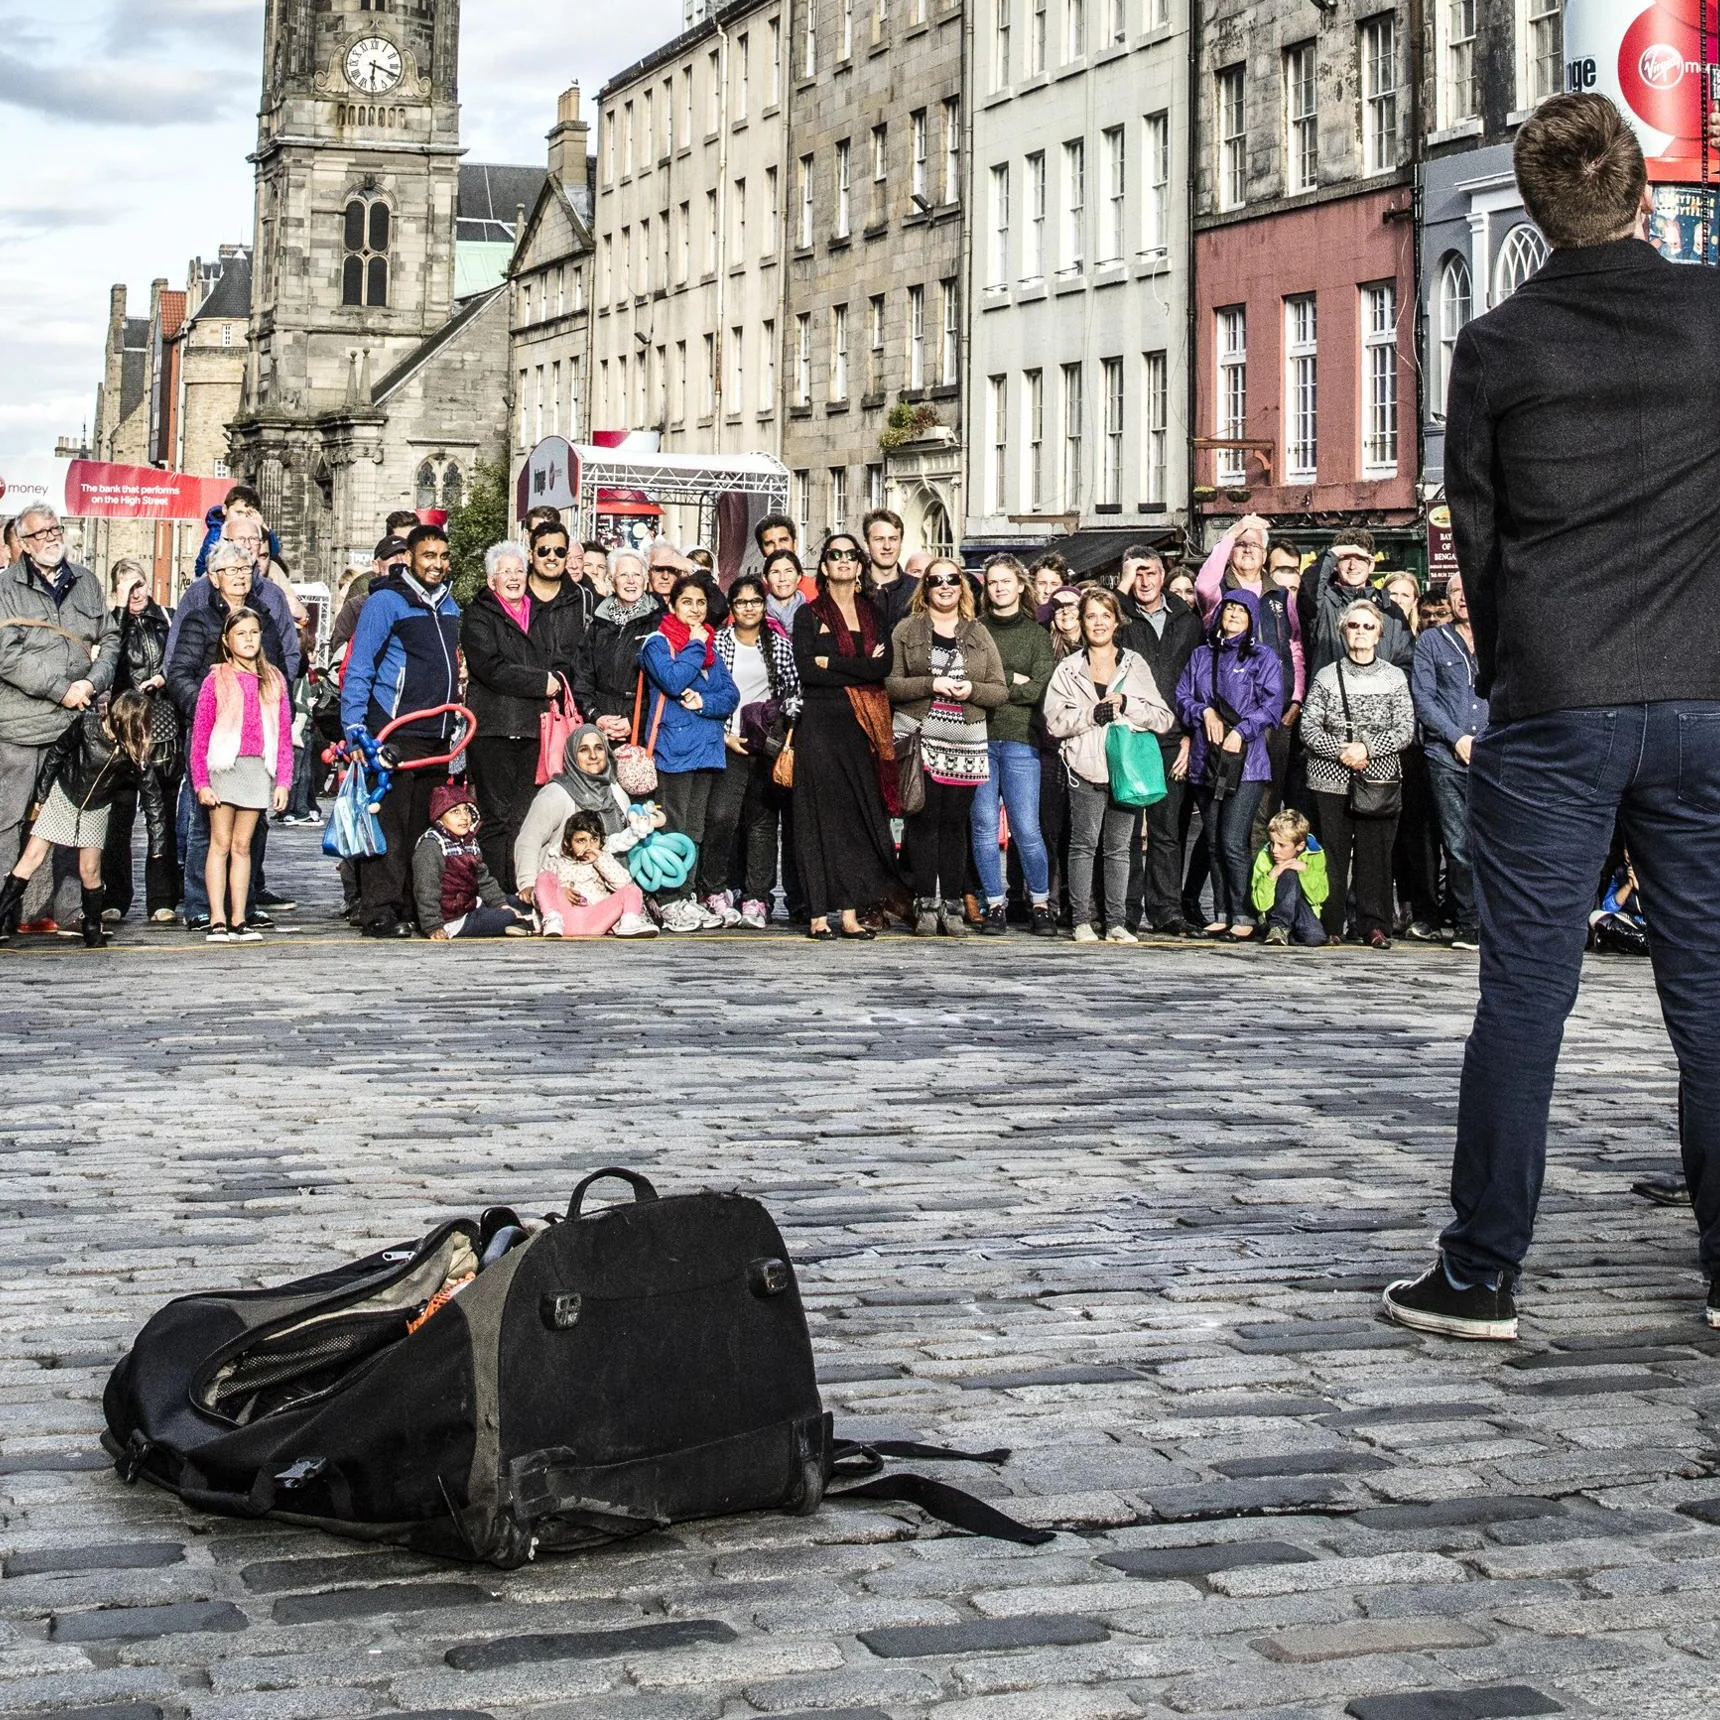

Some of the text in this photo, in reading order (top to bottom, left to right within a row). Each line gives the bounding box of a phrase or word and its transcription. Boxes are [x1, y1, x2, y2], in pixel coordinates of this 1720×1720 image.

[8, 483, 49, 497] money
[81, 484, 180, 496] The bank that performs
[104, 495, 119, 504] the
[120, 496, 141, 507] High
[142, 496, 168, 505] Street
[1442, 543, 1451, 551] OF
